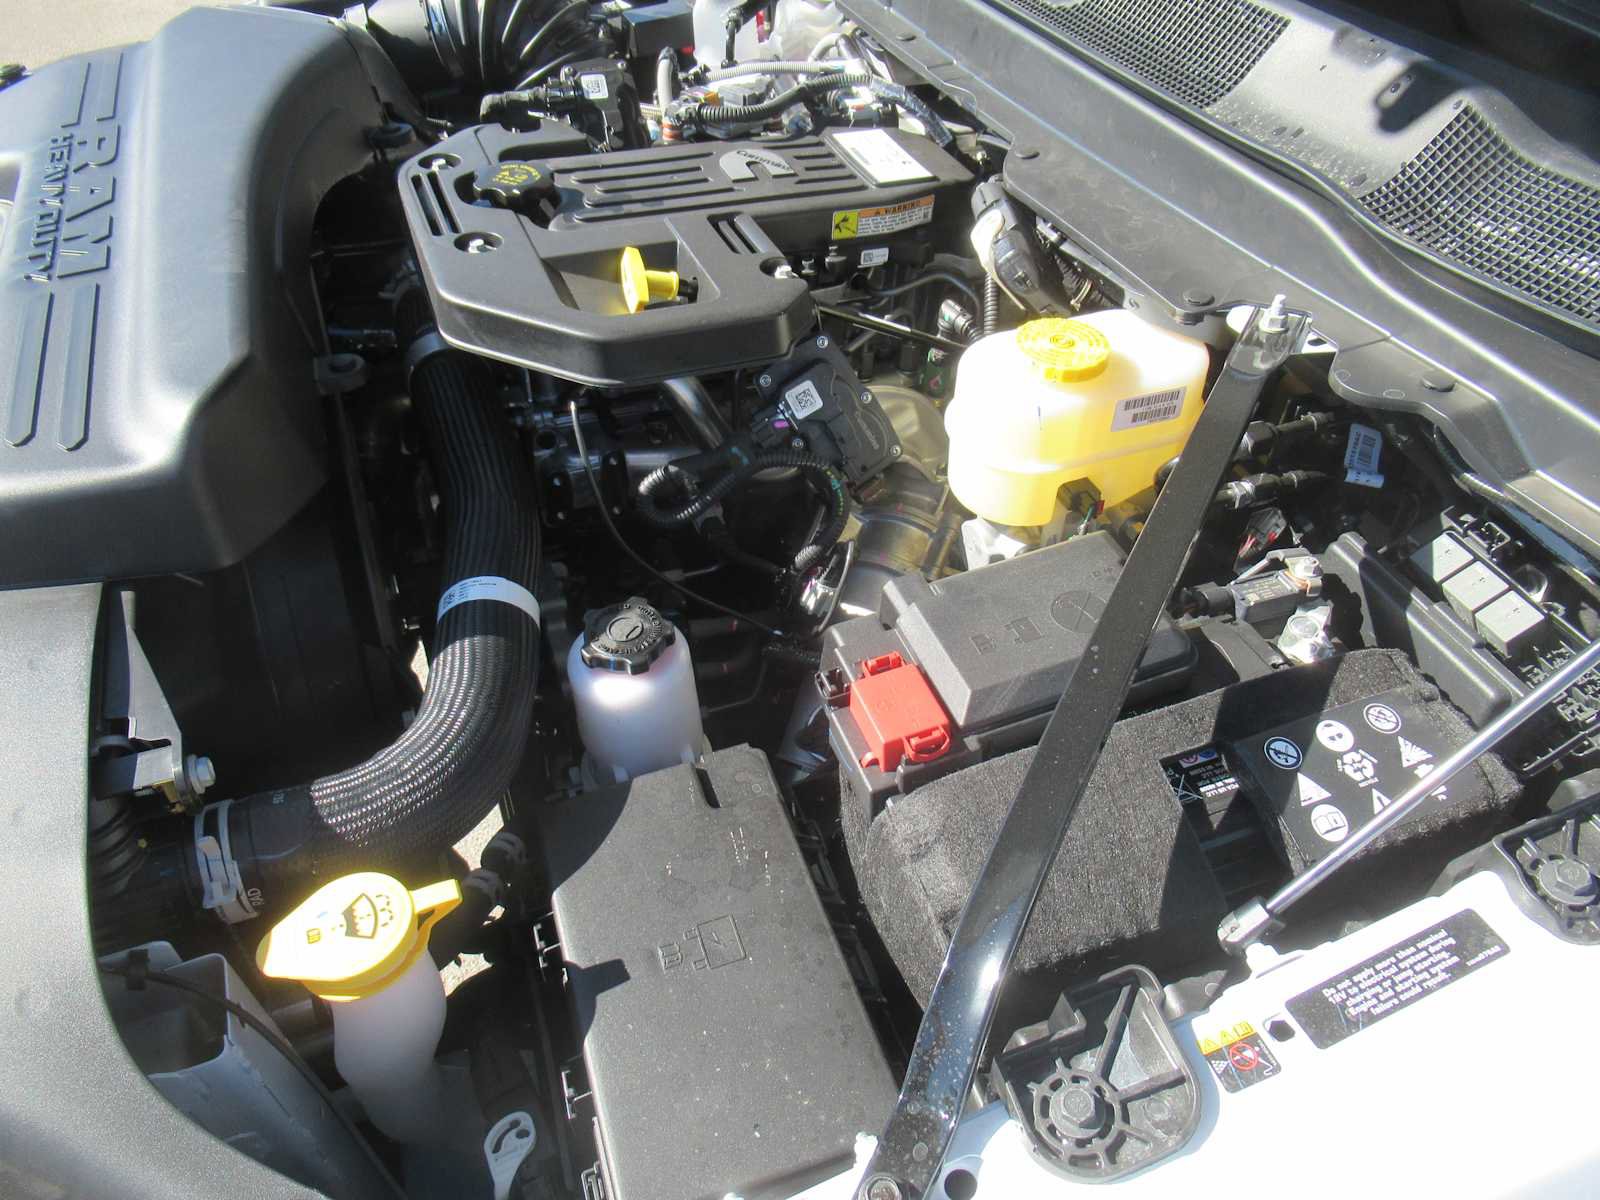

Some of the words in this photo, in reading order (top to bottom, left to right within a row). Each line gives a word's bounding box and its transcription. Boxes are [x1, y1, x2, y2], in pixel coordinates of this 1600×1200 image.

[40, 132, 74, 206] HEAVY
[736, 150, 792, 171] Cummins
[56, 124, 120, 279] RAM
[24, 206, 62, 282] DUTY
